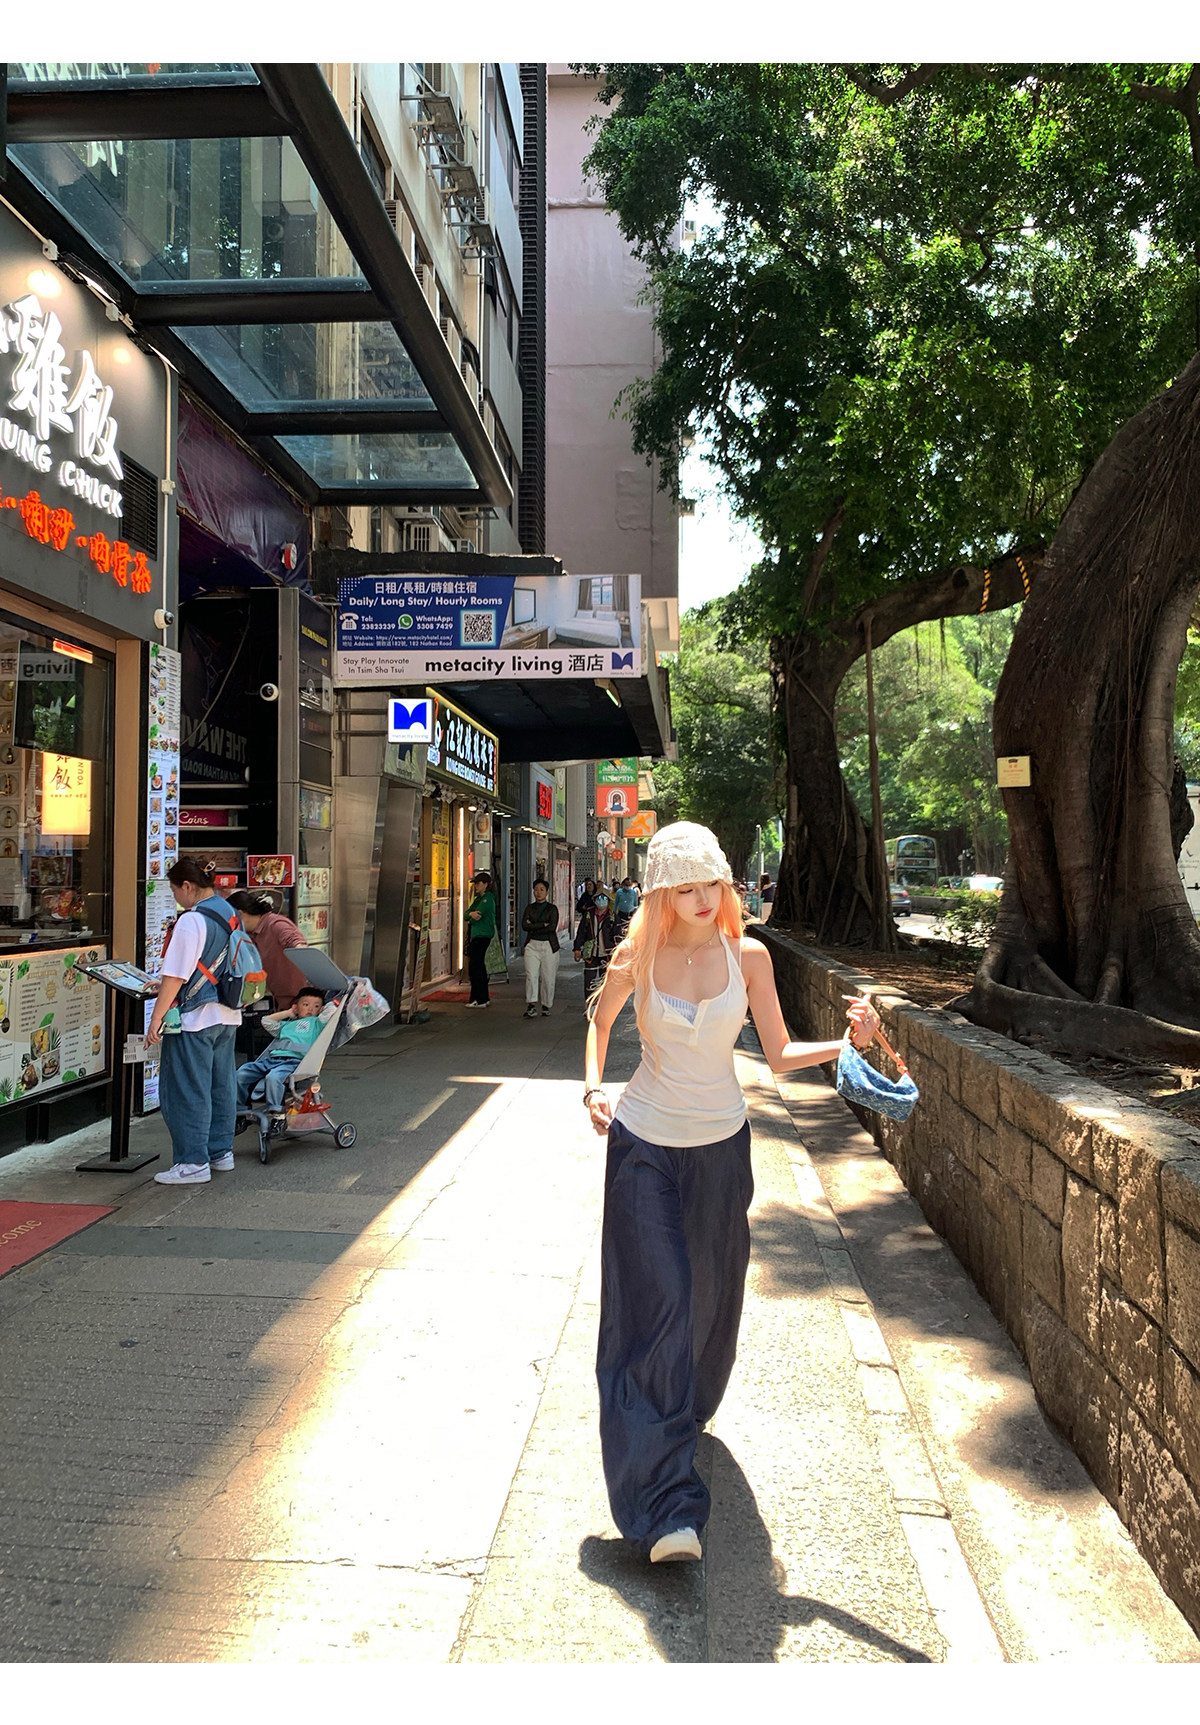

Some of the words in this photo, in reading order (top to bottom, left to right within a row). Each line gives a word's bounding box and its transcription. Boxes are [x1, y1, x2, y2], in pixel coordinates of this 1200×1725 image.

[59, 460, 123, 518] CHICK
[349, 597, 378, 607] Daily/
[381, 597, 404, 607] Long
[407, 597, 433, 607] Stay/
[435, 597, 467, 607] Hourly
[470, 596, 503, 605] Rooms
[415, 615, 453, 623] WhatsApp:
[343, 658, 359, 666] Stay
[361, 657, 376, 666] Play
[379, 657, 410, 665] Innovate
[425, 656, 505, 675] metacity
[512, 655, 563, 674] living
[568, 654, 604, 672] 酒店
